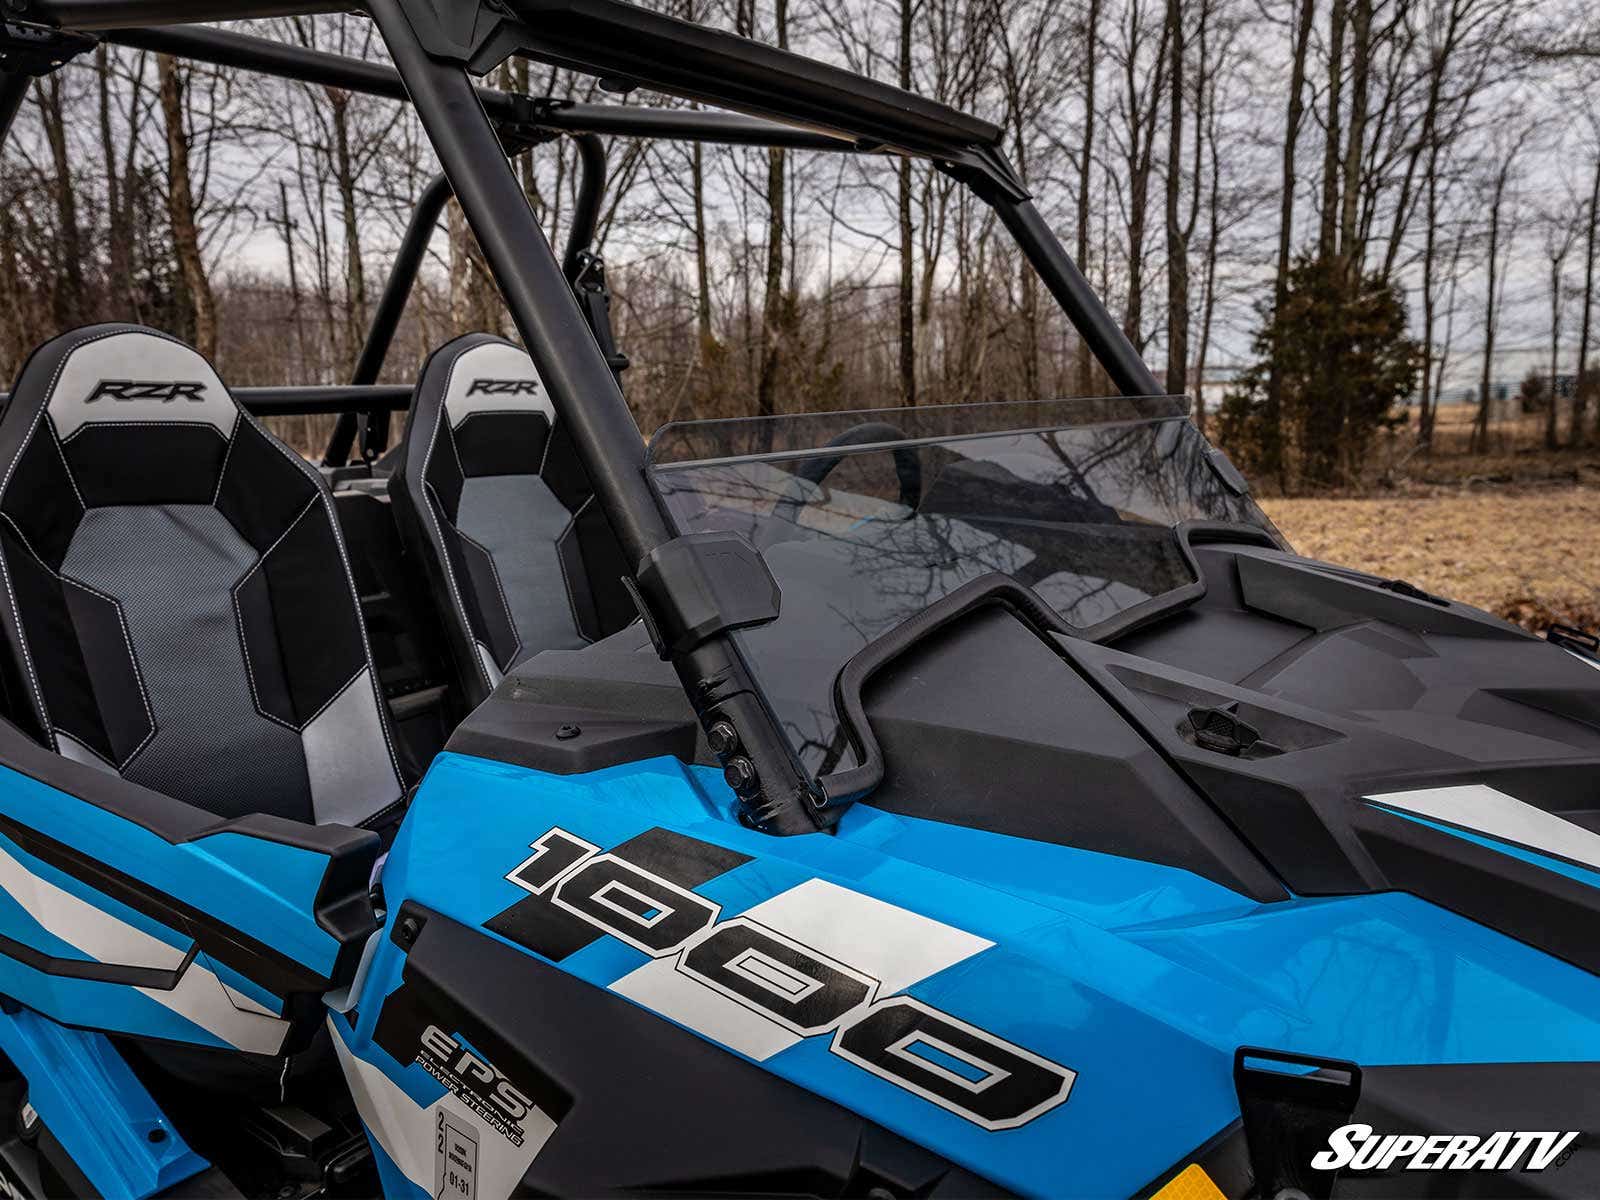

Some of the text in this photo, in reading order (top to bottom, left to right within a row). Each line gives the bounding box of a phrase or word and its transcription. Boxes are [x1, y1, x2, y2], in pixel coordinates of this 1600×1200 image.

[84, 379, 207, 403] RZR
[465, 378, 539, 398] RZR
[504, 826, 1077, 1132] 1000
[415, 1055, 524, 1146] POWER STEERING
[419, 1049, 524, 1138] ELECTRONIC
[420, 1024, 534, 1120] EPS
